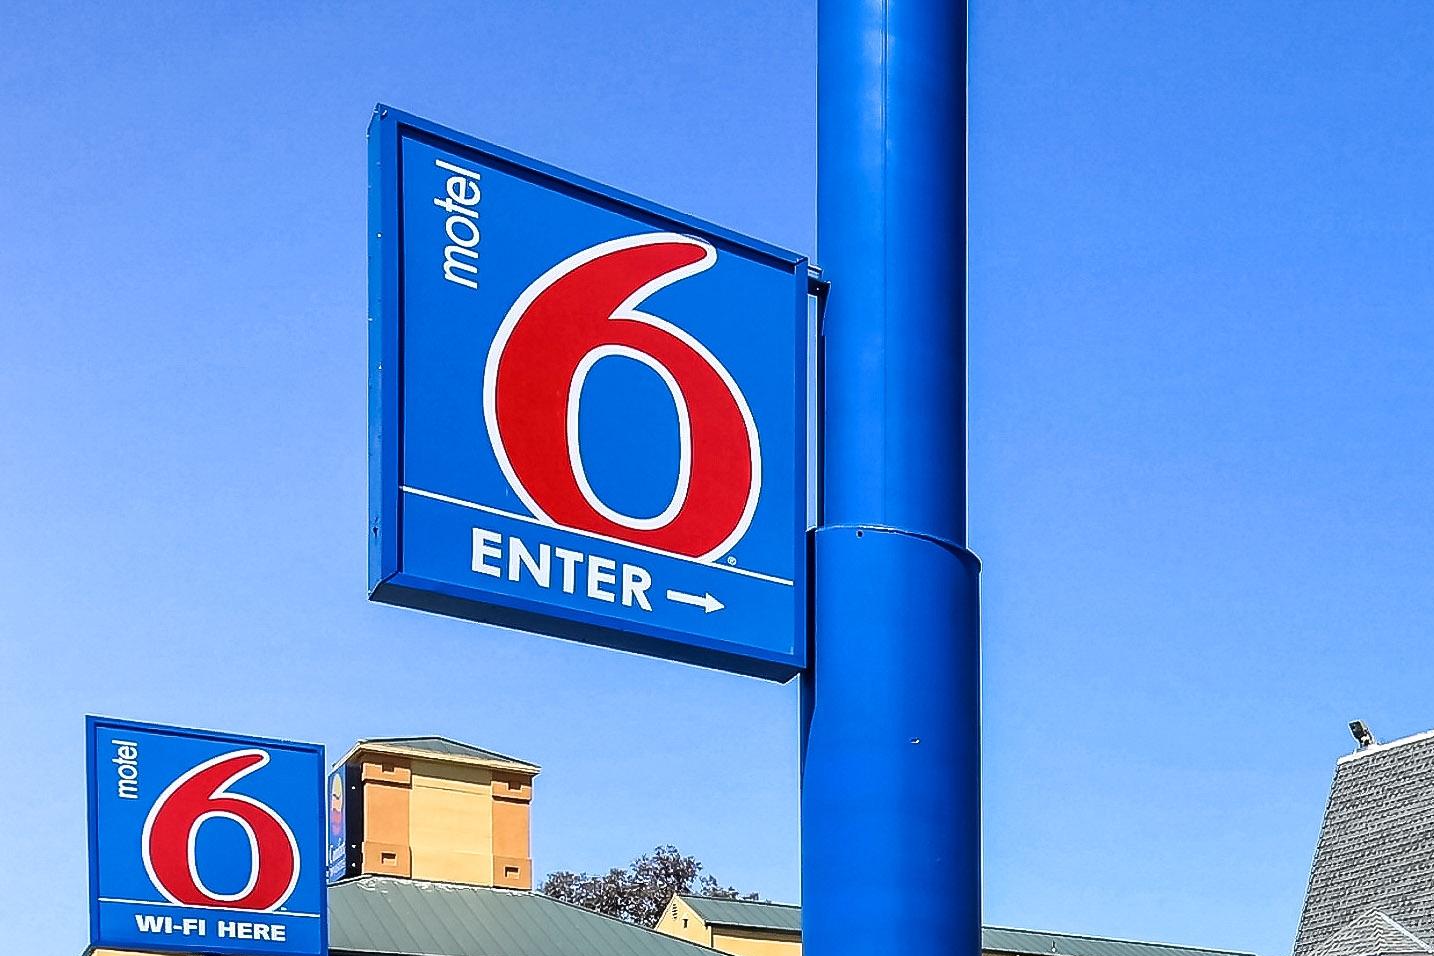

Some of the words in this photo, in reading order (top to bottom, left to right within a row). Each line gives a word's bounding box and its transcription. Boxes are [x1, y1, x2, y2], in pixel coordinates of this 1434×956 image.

[434, 159, 481, 289] motel
[483, 232, 762, 563] 6
[471, 527, 653, 612] ENTER
[111, 739, 138, 799] motel
[141, 748, 301, 912] 6
[135, 914, 206, 936] WI-FI
[218, 920, 286, 942] HERE
